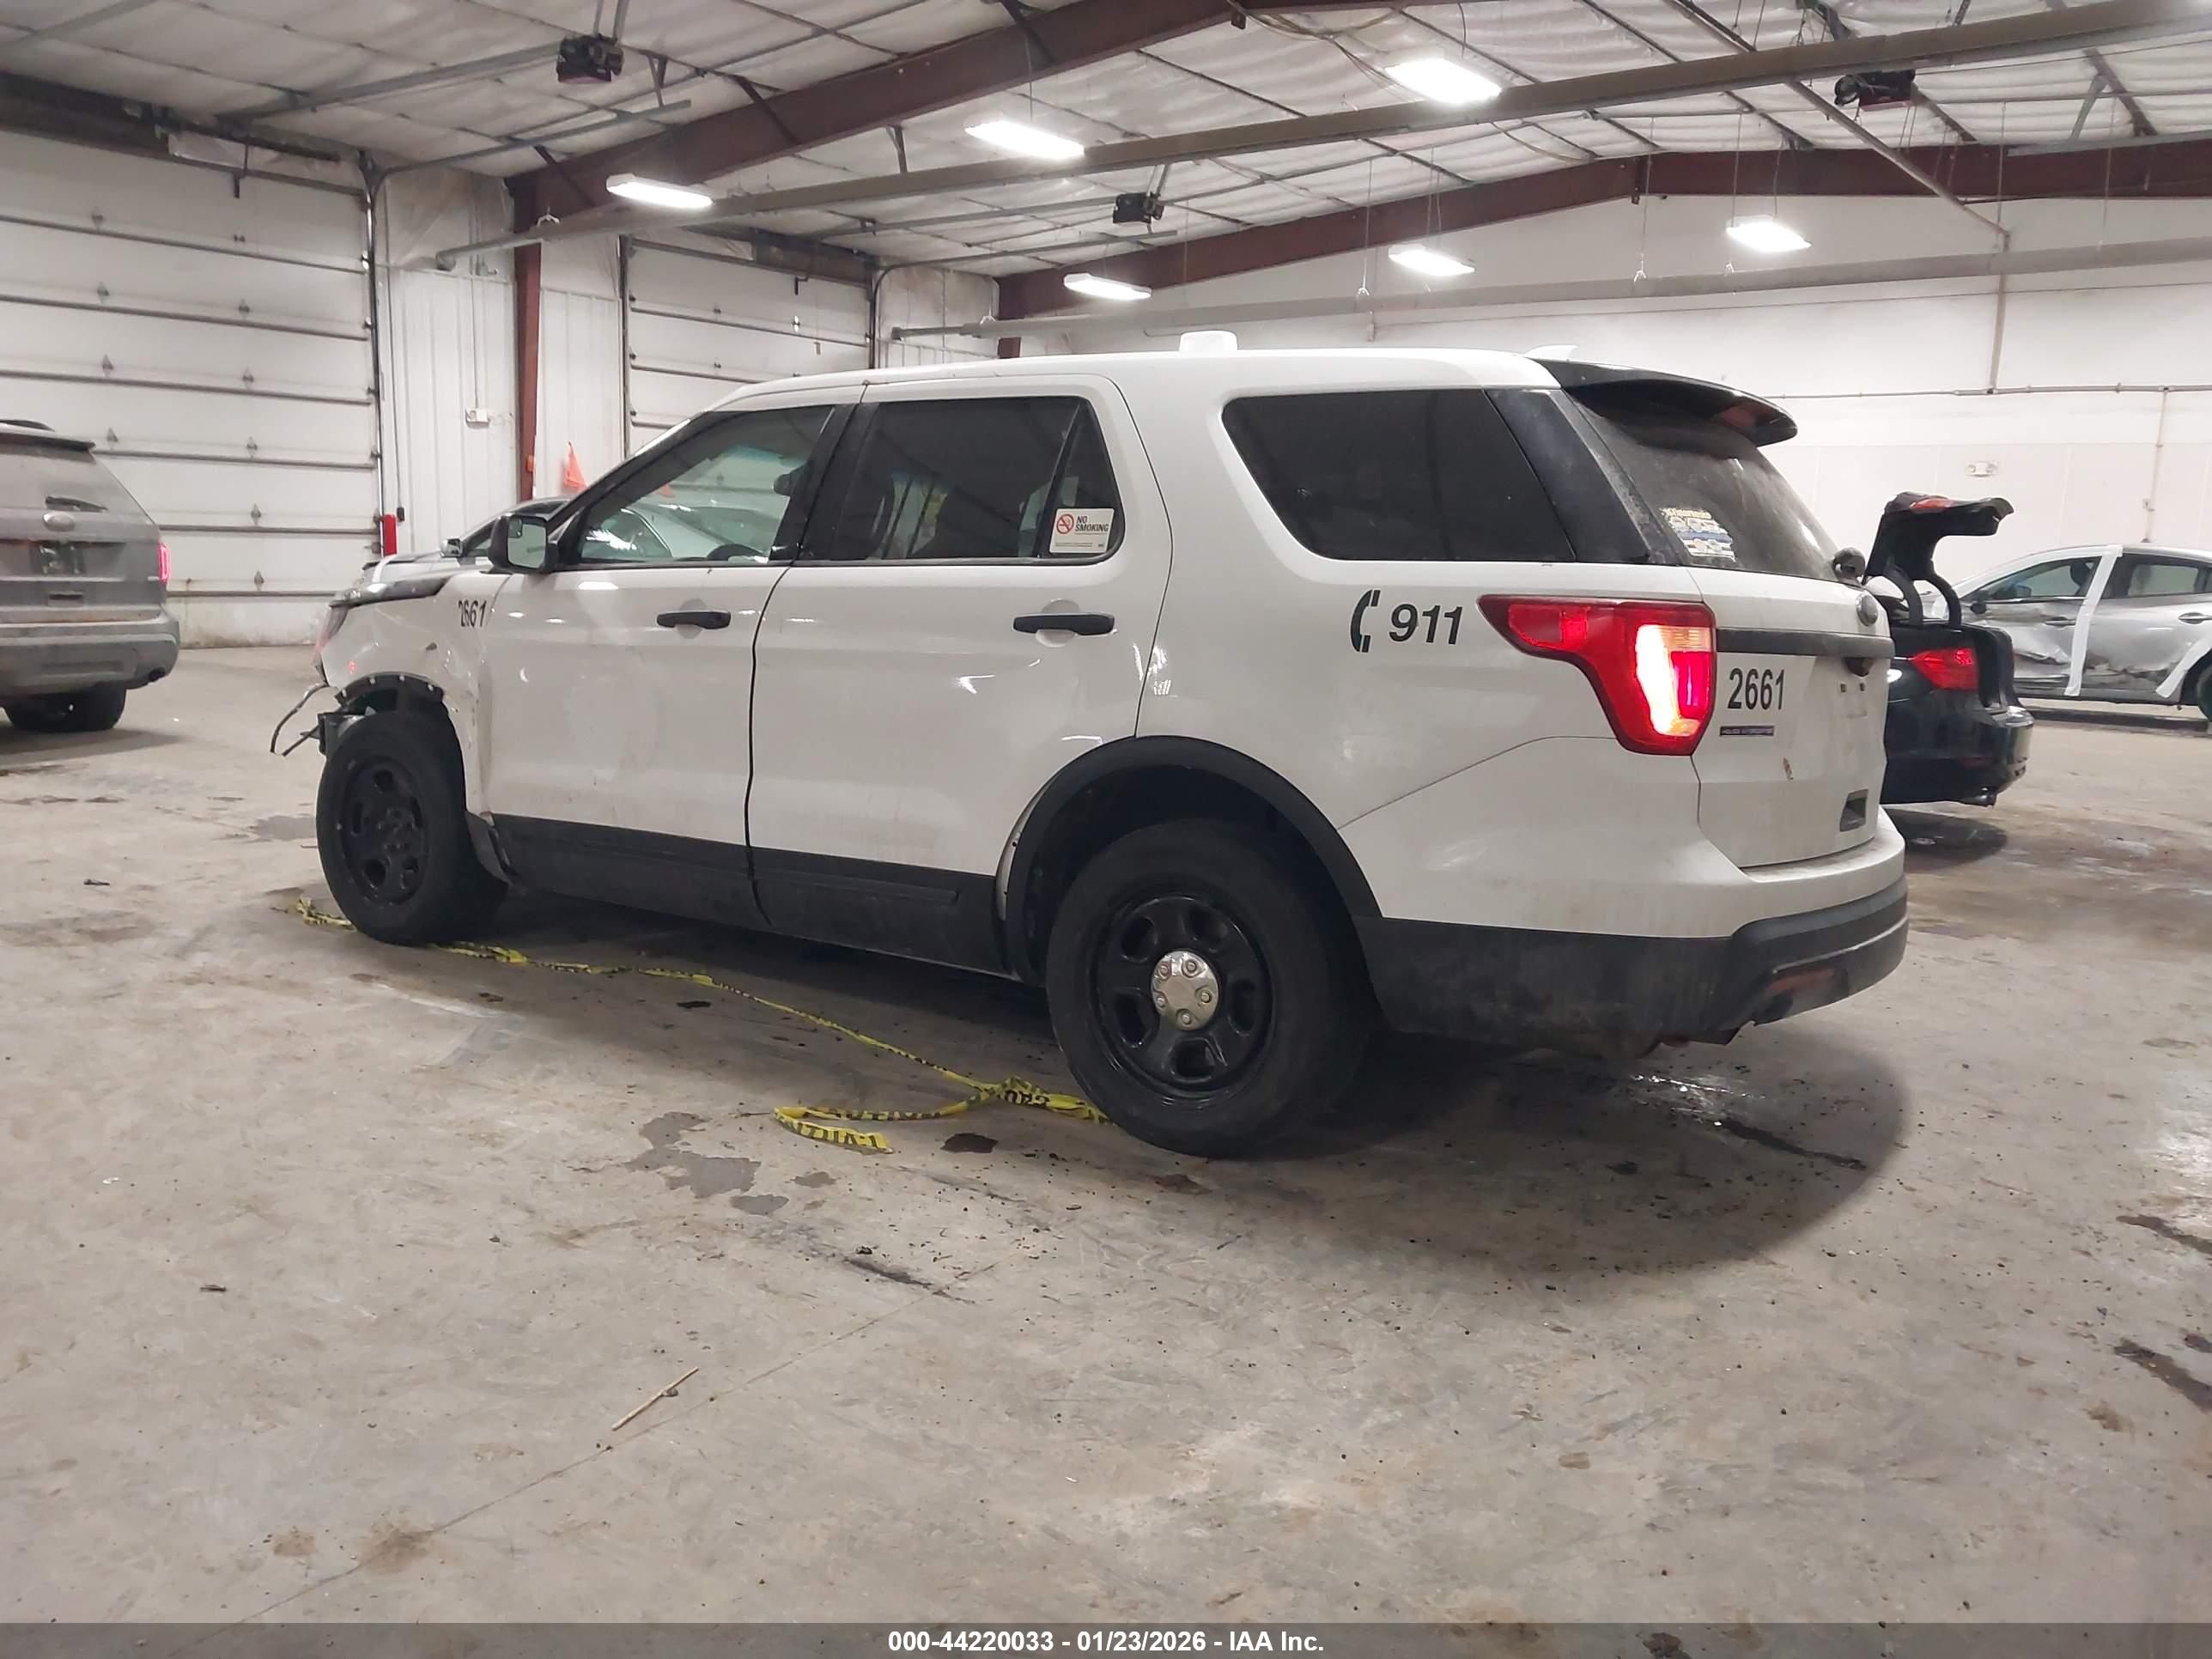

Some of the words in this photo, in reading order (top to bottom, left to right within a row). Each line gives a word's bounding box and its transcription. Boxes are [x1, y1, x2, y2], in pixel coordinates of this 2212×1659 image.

[1074, 523, 1109, 532] SMOKING
[458, 599, 487, 628] 2661
[1389, 603, 1463, 645] 911
[1727, 667, 1784, 710] 2661
